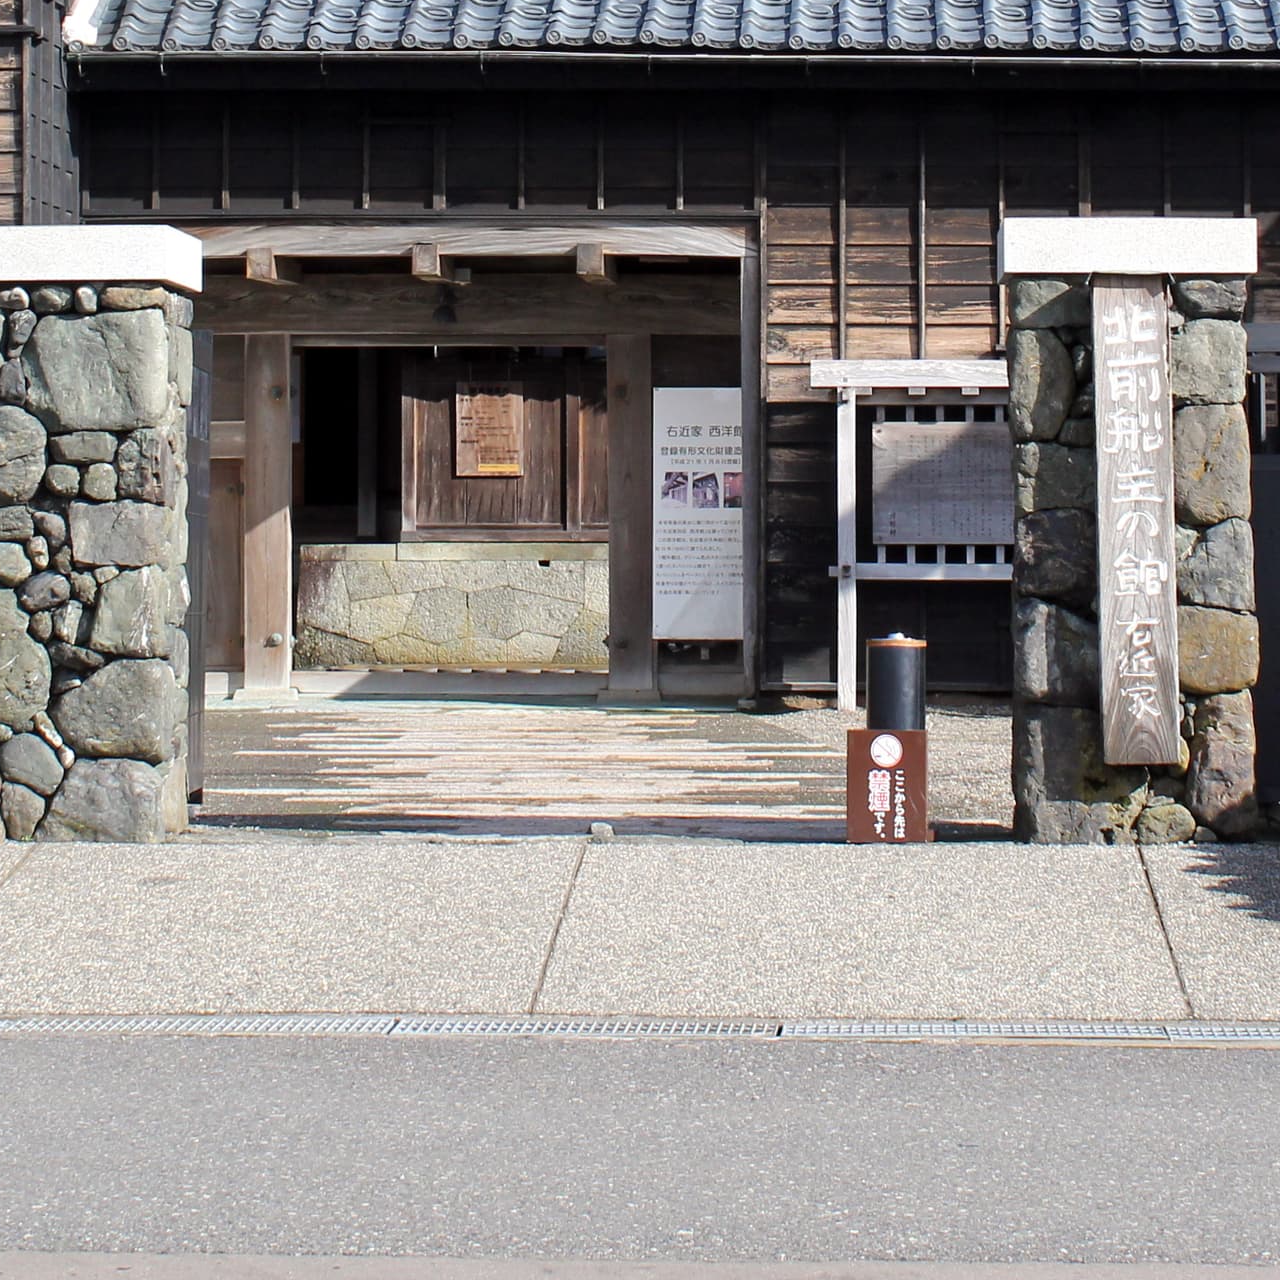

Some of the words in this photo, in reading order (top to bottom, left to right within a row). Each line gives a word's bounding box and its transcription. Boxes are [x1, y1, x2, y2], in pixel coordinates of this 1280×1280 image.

[667, 425, 703, 438] 右近家
[868, 770, 891, 838] 禁煙です。
[894, 769, 906, 838] ここから先は
